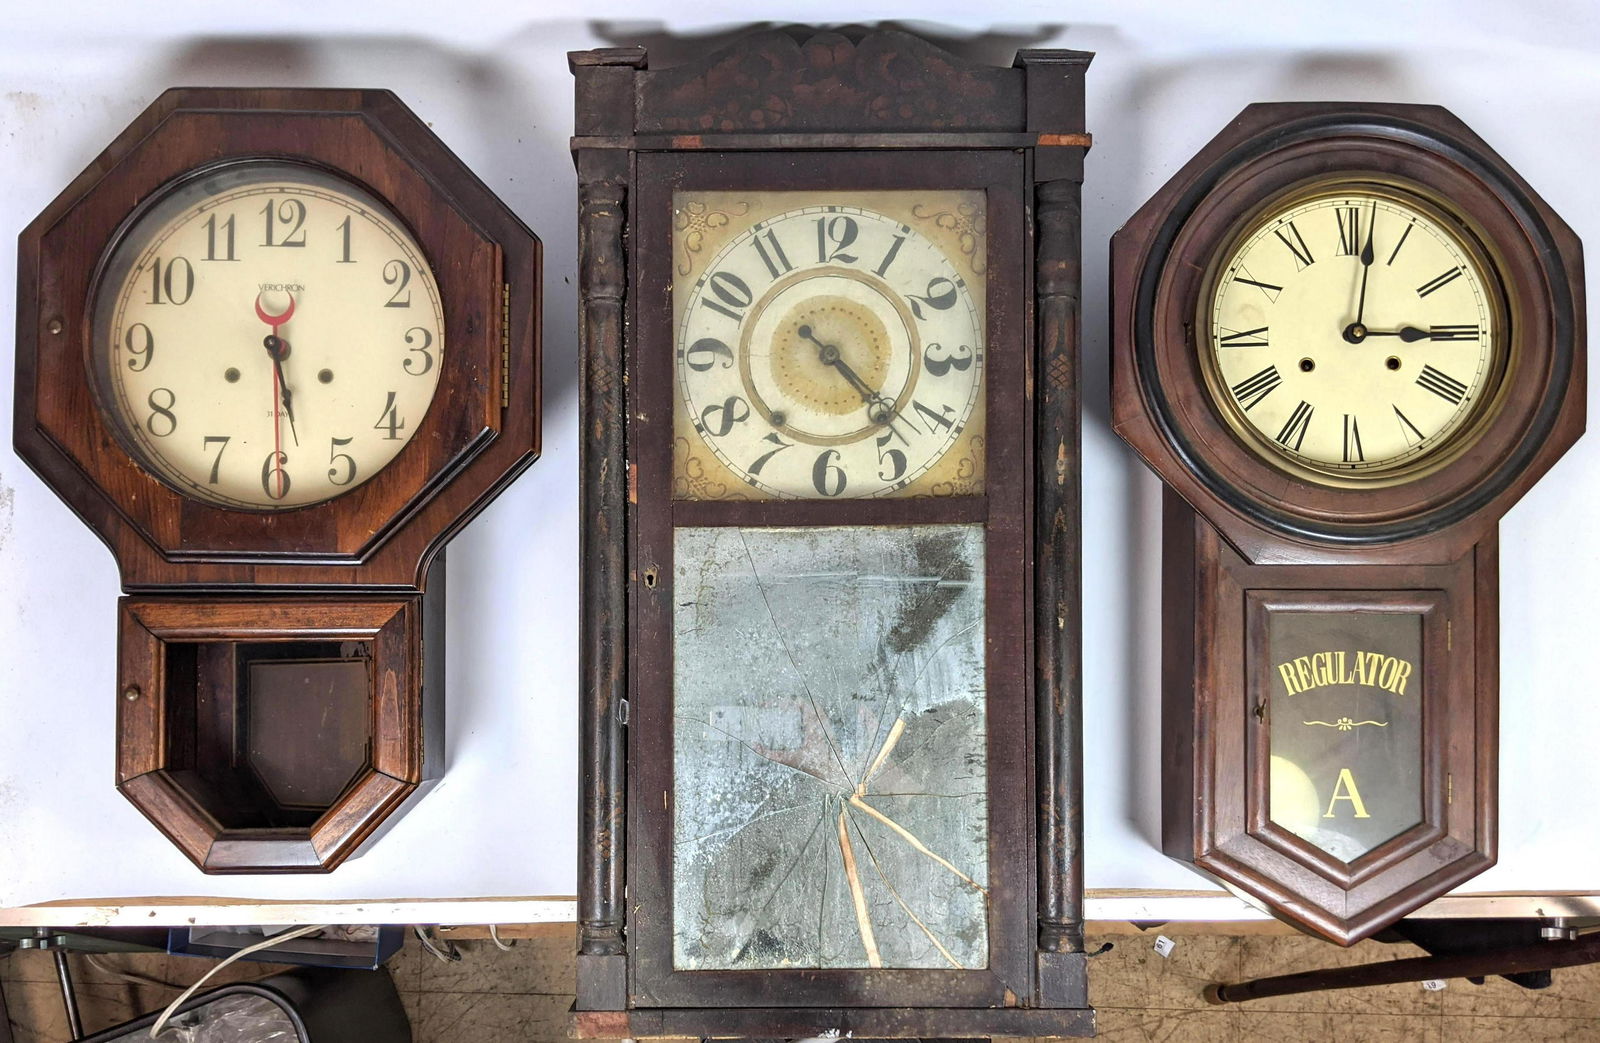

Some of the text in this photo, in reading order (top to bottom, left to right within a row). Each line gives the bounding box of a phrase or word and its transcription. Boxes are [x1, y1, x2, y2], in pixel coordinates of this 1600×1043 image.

[201, 213, 241, 261] 11
[259, 198, 306, 247] 12
[336, 214, 358, 263] 1
[811, 216, 859, 264] 12
[1273, 220, 1315, 273] XI
[1335, 207, 1360, 256] XII
[1386, 223, 1414, 266] I
[749, 228, 800, 283] 11
[871, 233, 906, 280] 1
[145, 256, 195, 305] 10
[258, 283, 305, 292] VERICHRON
[382, 259, 411, 308] 2
[700, 271, 753, 330] 10
[904, 277, 958, 321] 2
[1233, 264, 1285, 304] X
[1416, 265, 1463, 299] II
[125, 323, 154, 372] 9
[403, 326, 433, 376] 3
[686, 337, 735, 372] 9
[1220, 326, 1269, 348] IX
[1430, 324, 1480, 342] III
[923, 342, 973, 377] 3
[1231, 364, 1284, 413] VIII
[1415, 363, 1468, 406] IIII
[147, 388, 177, 437] 8
[374, 391, 405, 440] 4
[700, 395, 750, 437] 8
[912, 399, 957, 436] 4
[1275, 400, 1315, 452] VII
[1391, 402, 1426, 448] V
[203, 435, 231, 484] 7
[327, 437, 357, 486] 5
[747, 431, 795, 476] 7
[877, 432, 908, 482] 5
[1342, 413, 1365, 463] VI
[261, 450, 291, 500] 6
[812, 449, 847, 497] 6
[1278, 651, 1412, 696] REGULATOR
[1322, 768, 1371, 819] A
